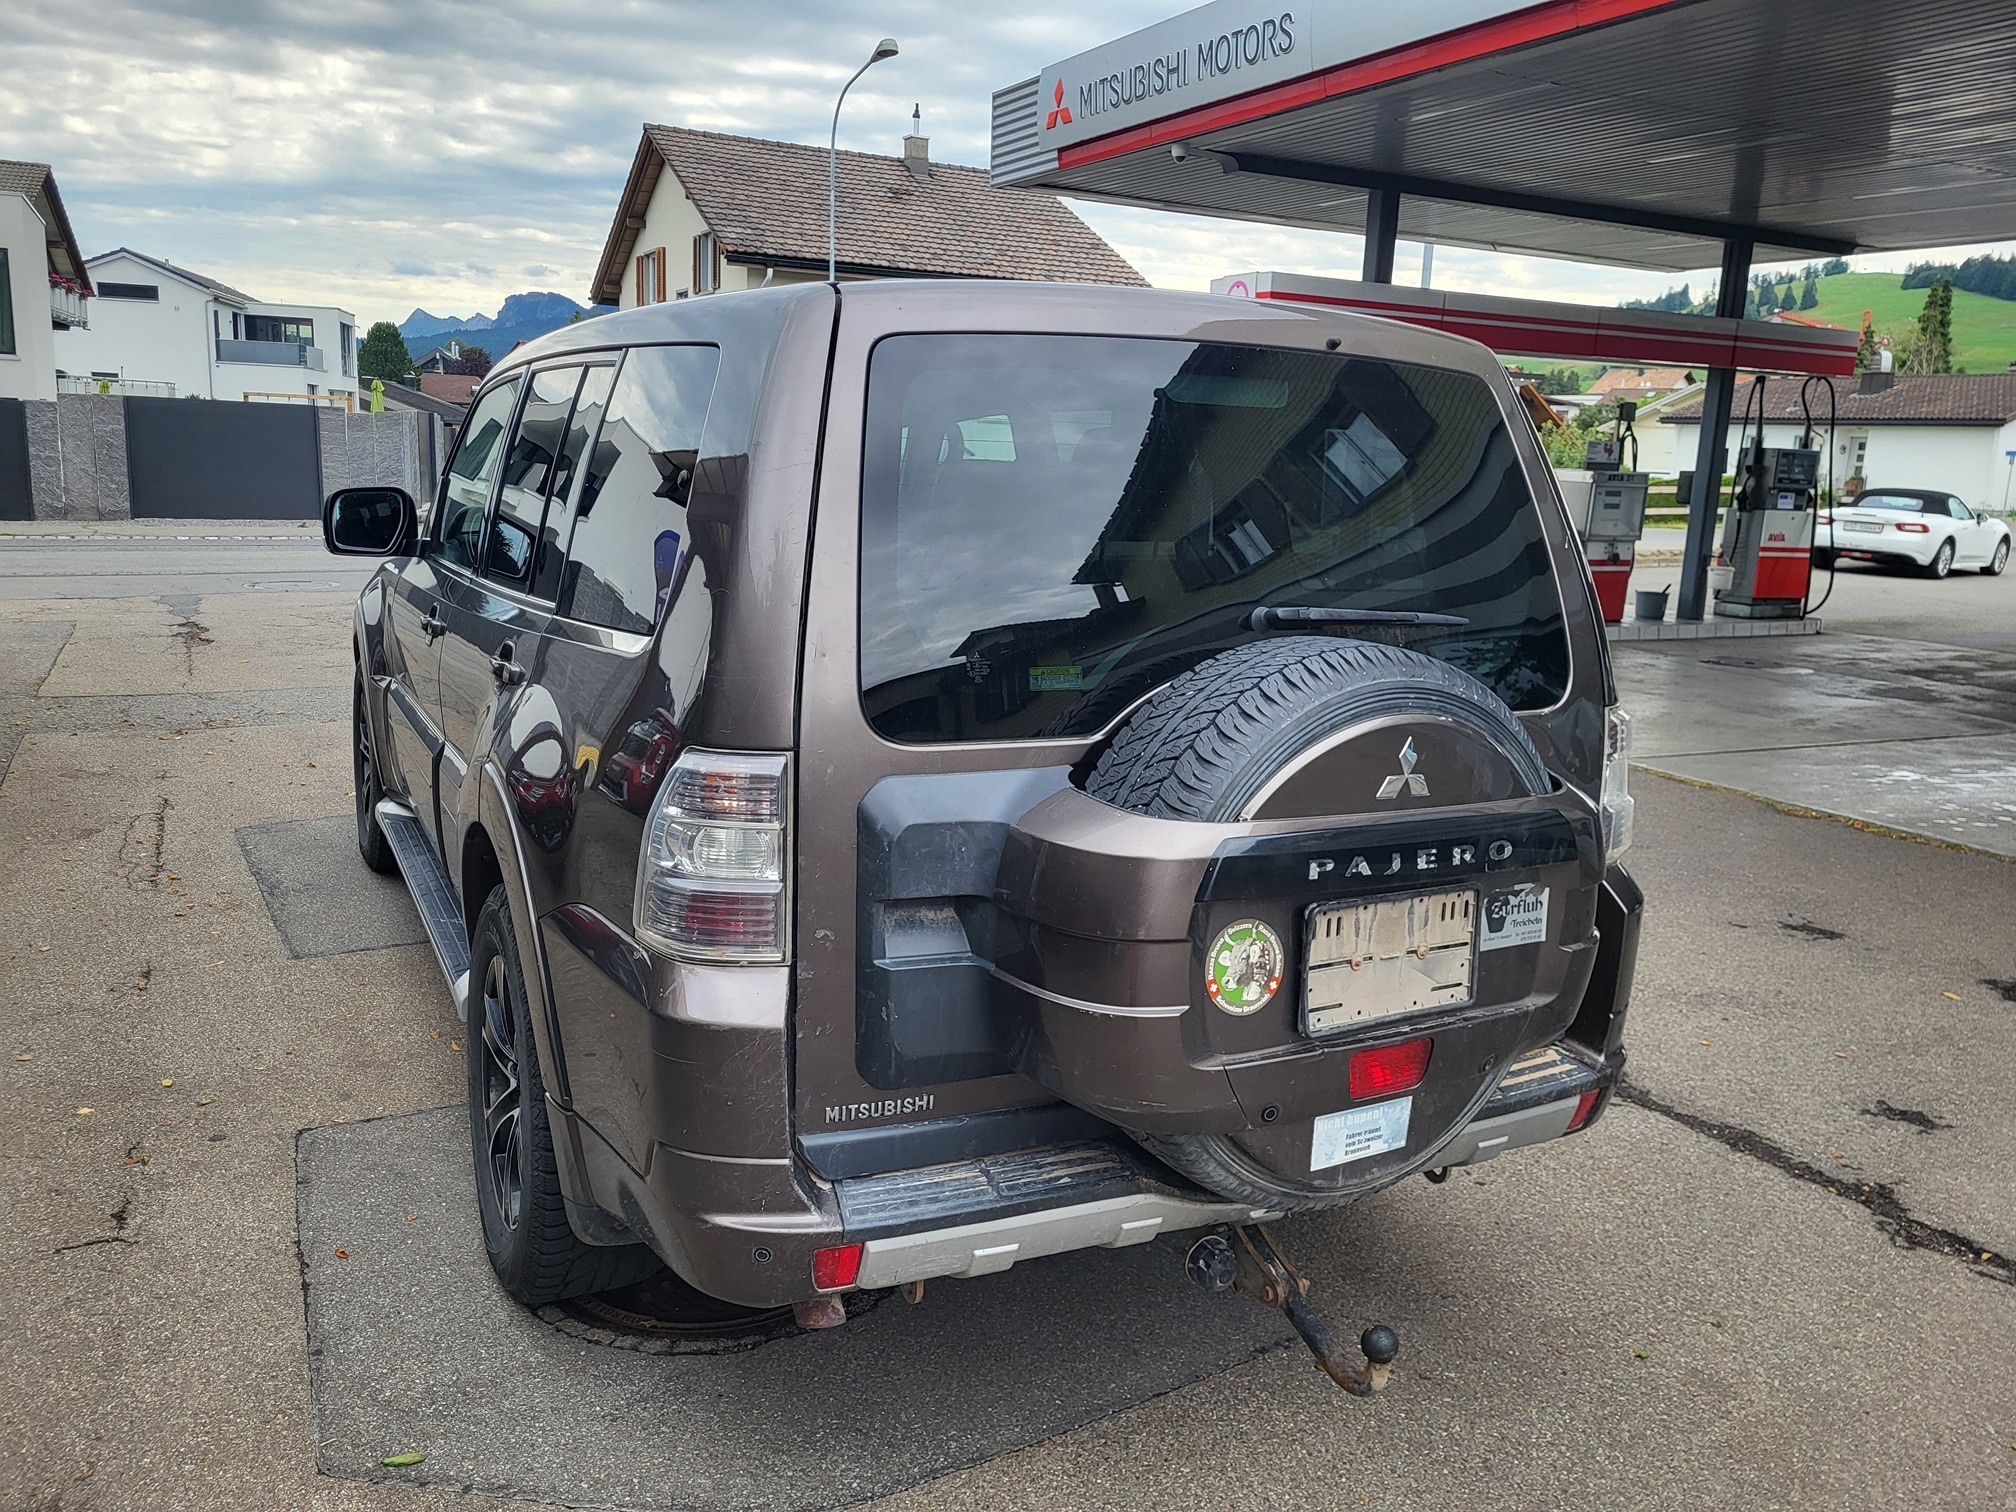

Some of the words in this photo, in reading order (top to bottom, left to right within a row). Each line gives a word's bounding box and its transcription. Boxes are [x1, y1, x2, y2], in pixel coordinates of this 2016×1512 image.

[1079, 48, 1190, 119] MITSUBISHI
[1198, 12, 1296, 82] MOTORS
[1308, 839, 1514, 880] PAJERO
[1210, 937, 1225, 958] Bruna
[1227, 923, 1252, 936] Svizzera
[1216, 995, 1243, 1013] Schweizer
[825, 1094, 935, 1124] MITSUBISHI
